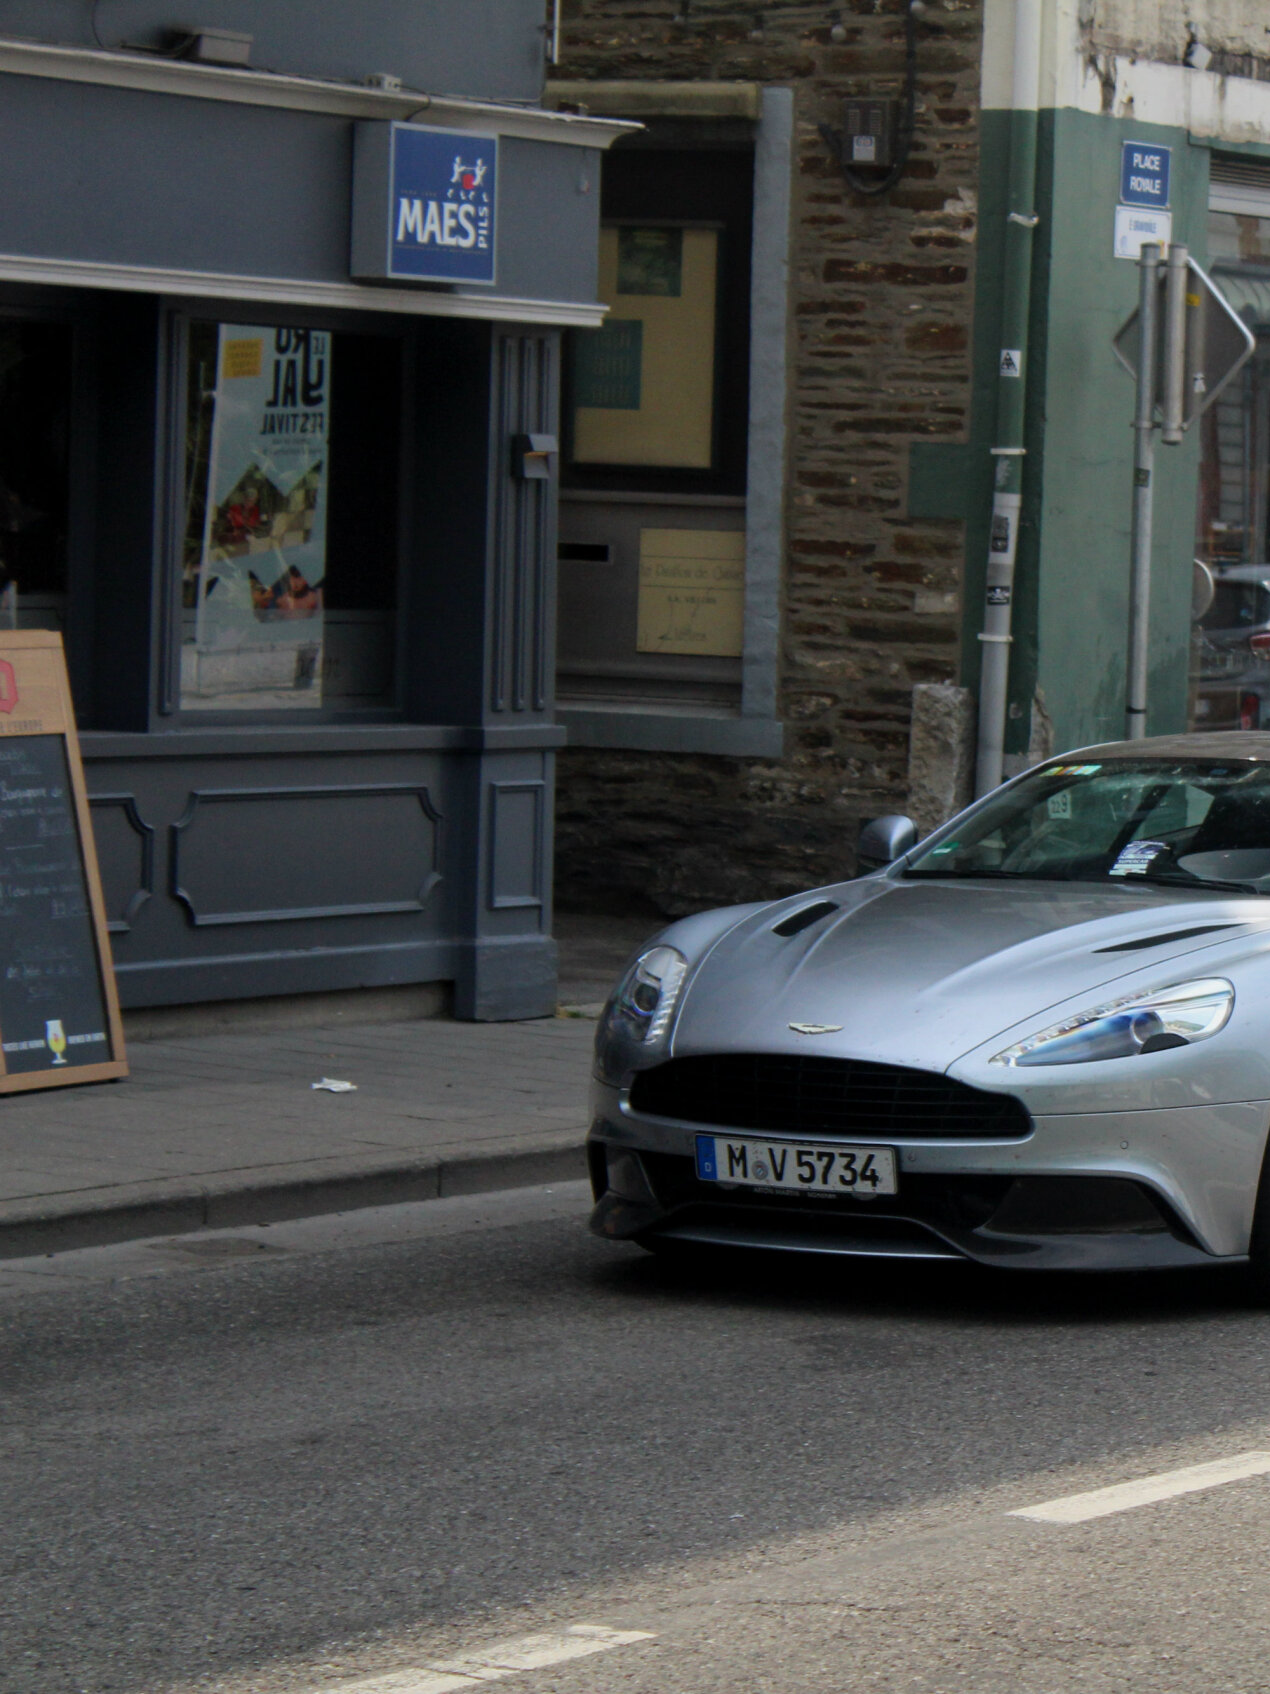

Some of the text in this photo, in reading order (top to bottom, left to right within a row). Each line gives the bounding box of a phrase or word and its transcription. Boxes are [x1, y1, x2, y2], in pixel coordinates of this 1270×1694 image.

[1132, 153, 1161, 171] PLACE
[1129, 175, 1162, 195] ROYALE
[396, 197, 477, 249] MAES
[477, 205, 490, 249] PILS
[727, 1144, 880, 1187] M V 5734
